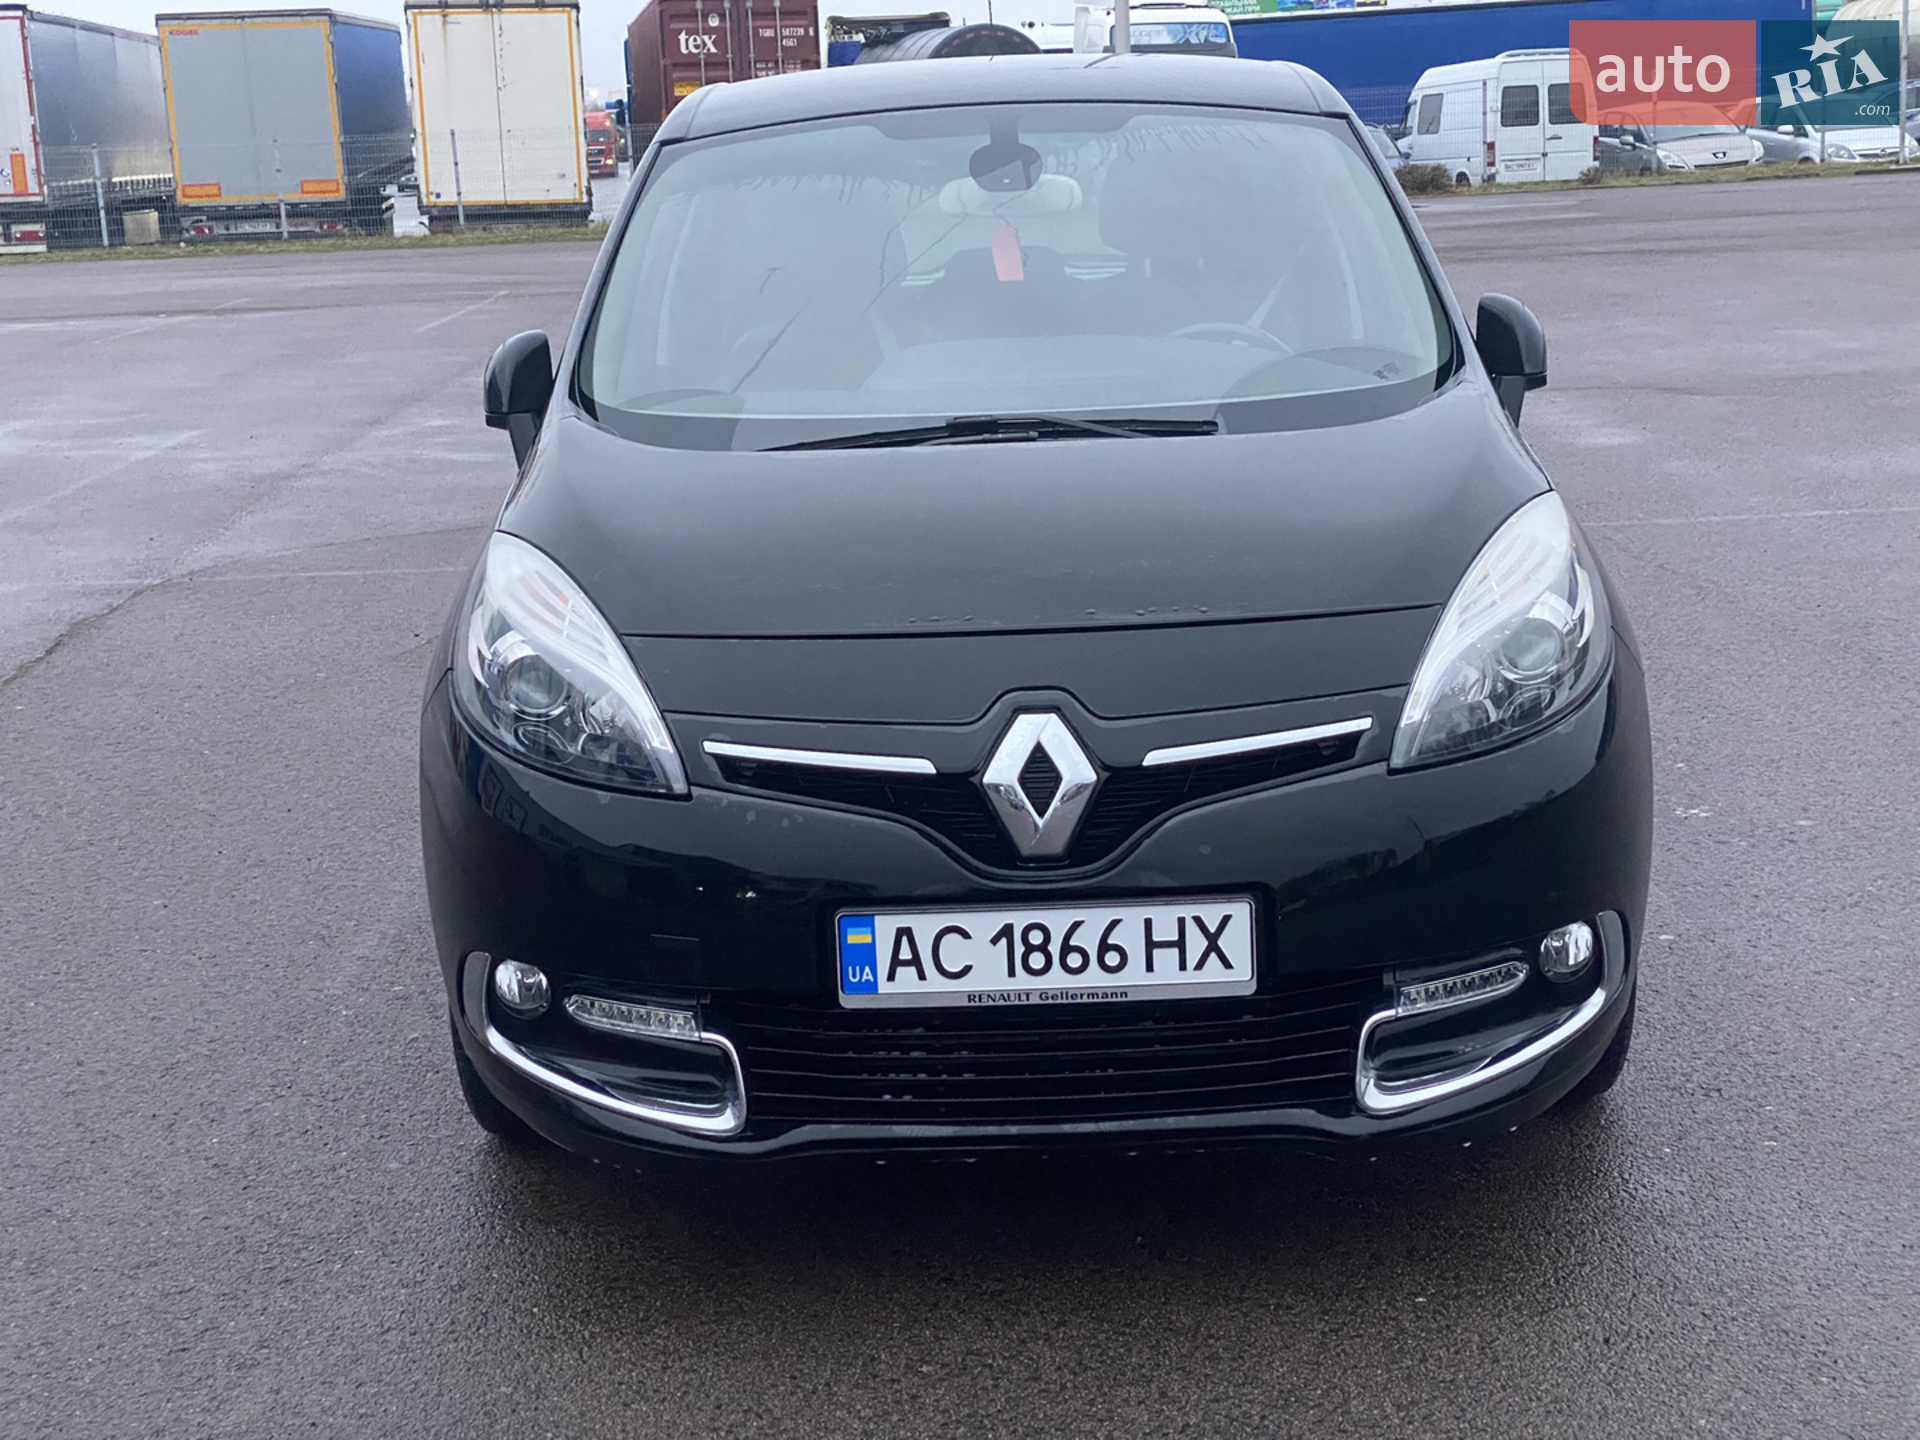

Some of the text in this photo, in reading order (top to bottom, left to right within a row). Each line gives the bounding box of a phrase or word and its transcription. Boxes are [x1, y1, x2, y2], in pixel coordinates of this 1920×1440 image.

[678, 29, 719, 54] tex
[886, 913, 1235, 983] AC 1866 HX
[848, 965, 874, 984] UA
[967, 988, 1129, 1004] RENAULT Gellermann
